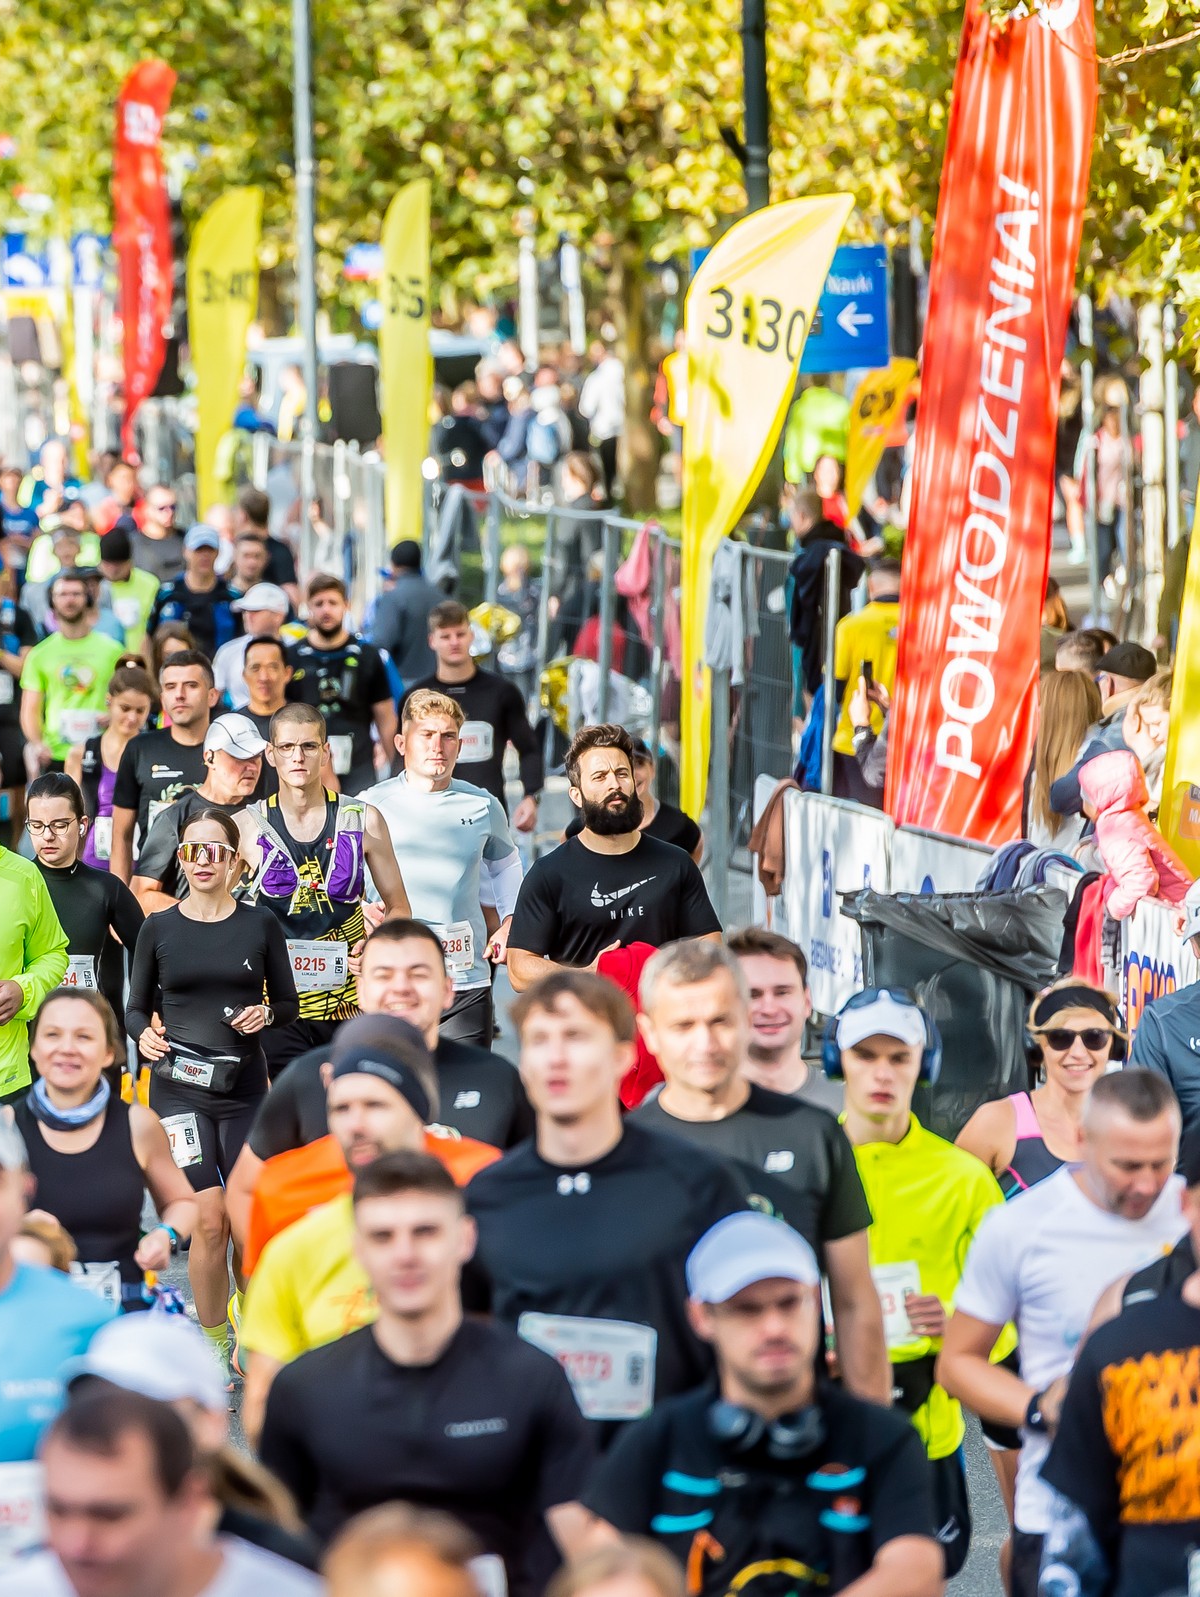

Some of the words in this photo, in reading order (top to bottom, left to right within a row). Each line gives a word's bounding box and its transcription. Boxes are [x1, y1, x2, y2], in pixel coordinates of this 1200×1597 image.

[707, 285, 806, 363] 3:30
[936, 172, 1040, 780] POWODZENIA!
[610, 906, 644, 920] NIKE
[294, 956, 326, 972] 8215
[184, 1065, 203, 1076] 7607
